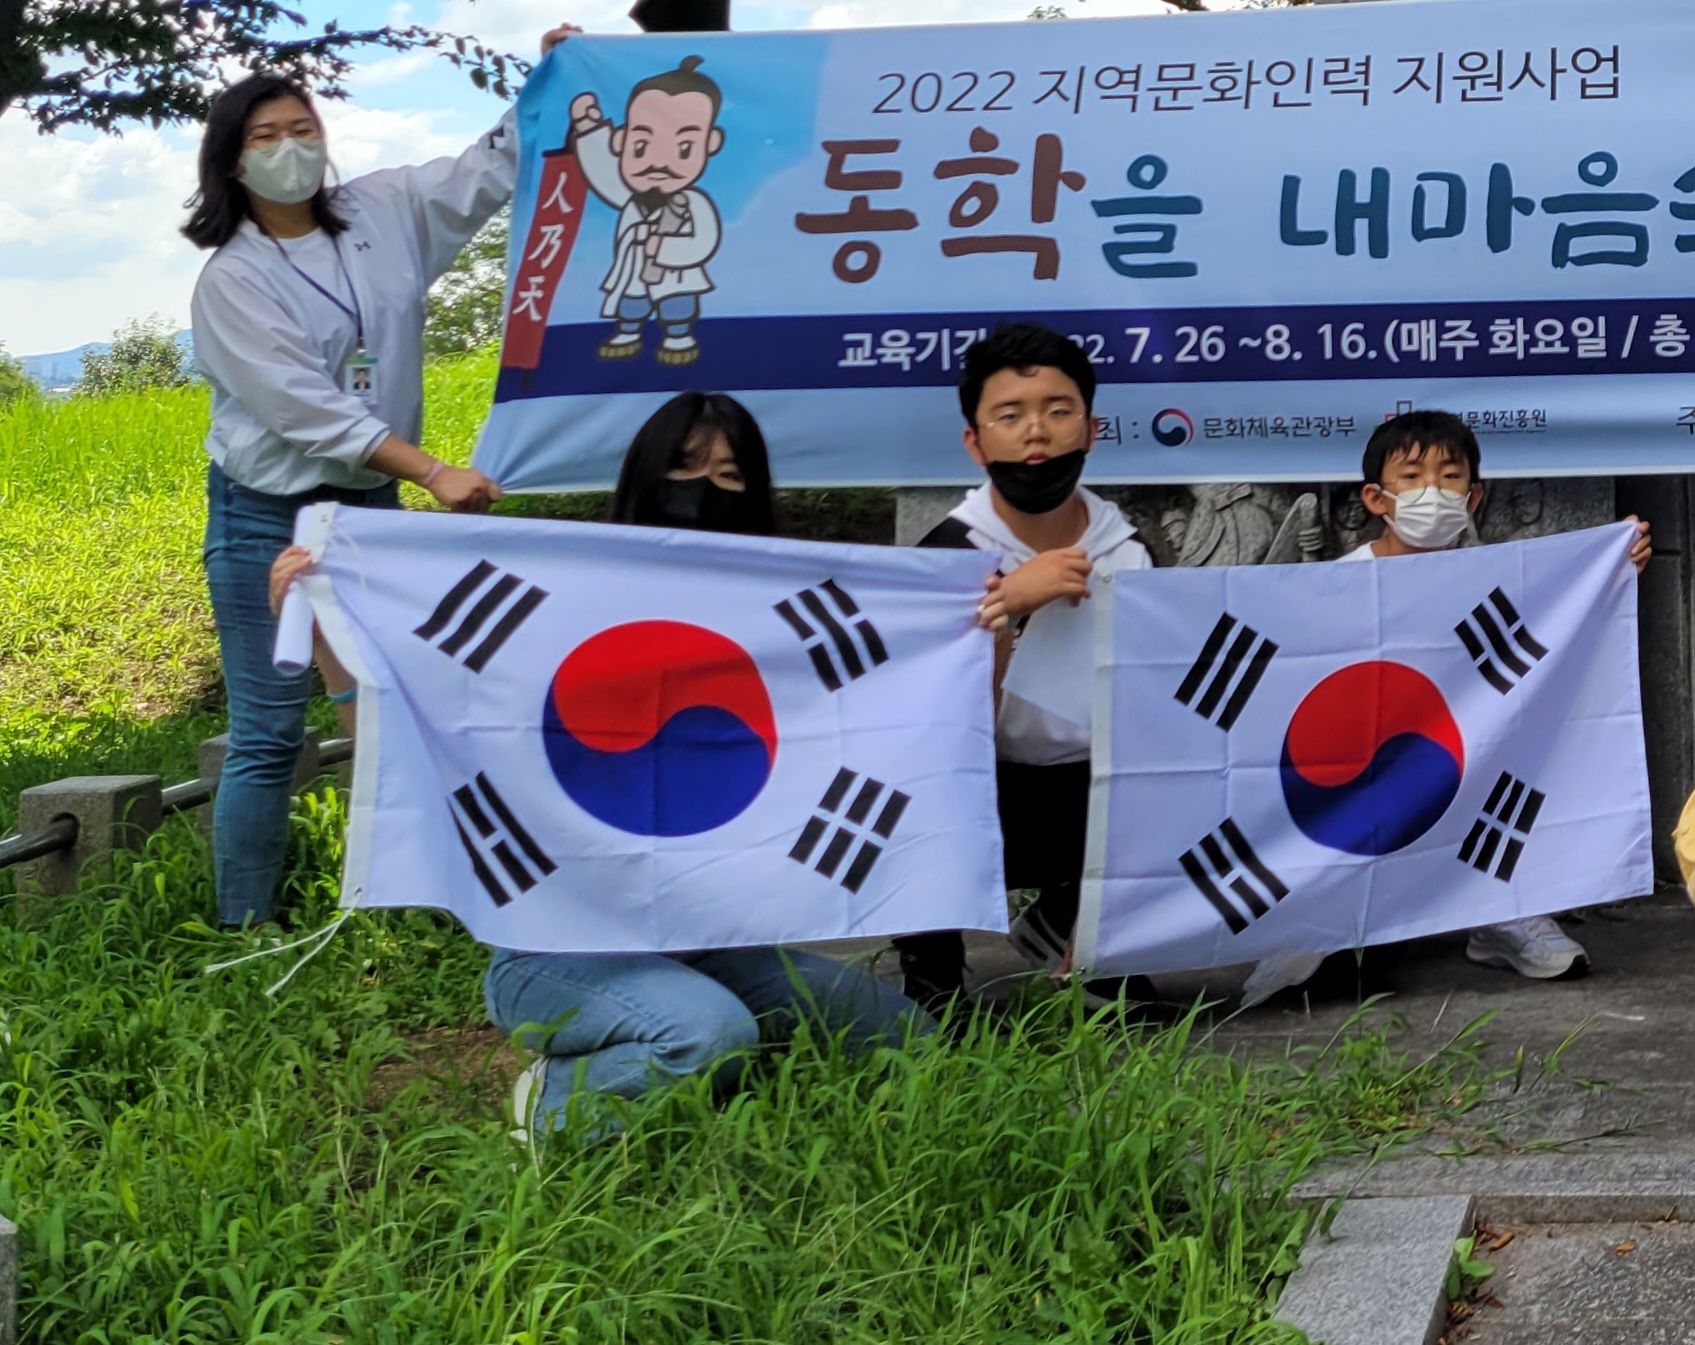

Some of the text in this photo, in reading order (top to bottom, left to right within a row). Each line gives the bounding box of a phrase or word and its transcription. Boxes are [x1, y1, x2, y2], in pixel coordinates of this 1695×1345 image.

[872, 44, 1619, 115] 2022 지역문화인력 지원사업
[795, 126, 1203, 284] 동학을
[1175, 325, 1226, 362] 26
[1489, 315, 1607, 360] 화요일
[1649, 314, 1690, 357] 총
[1203, 416, 1357, 439] 문화체육관광부
[1456, 409, 1547, 429] 문화진흥원
